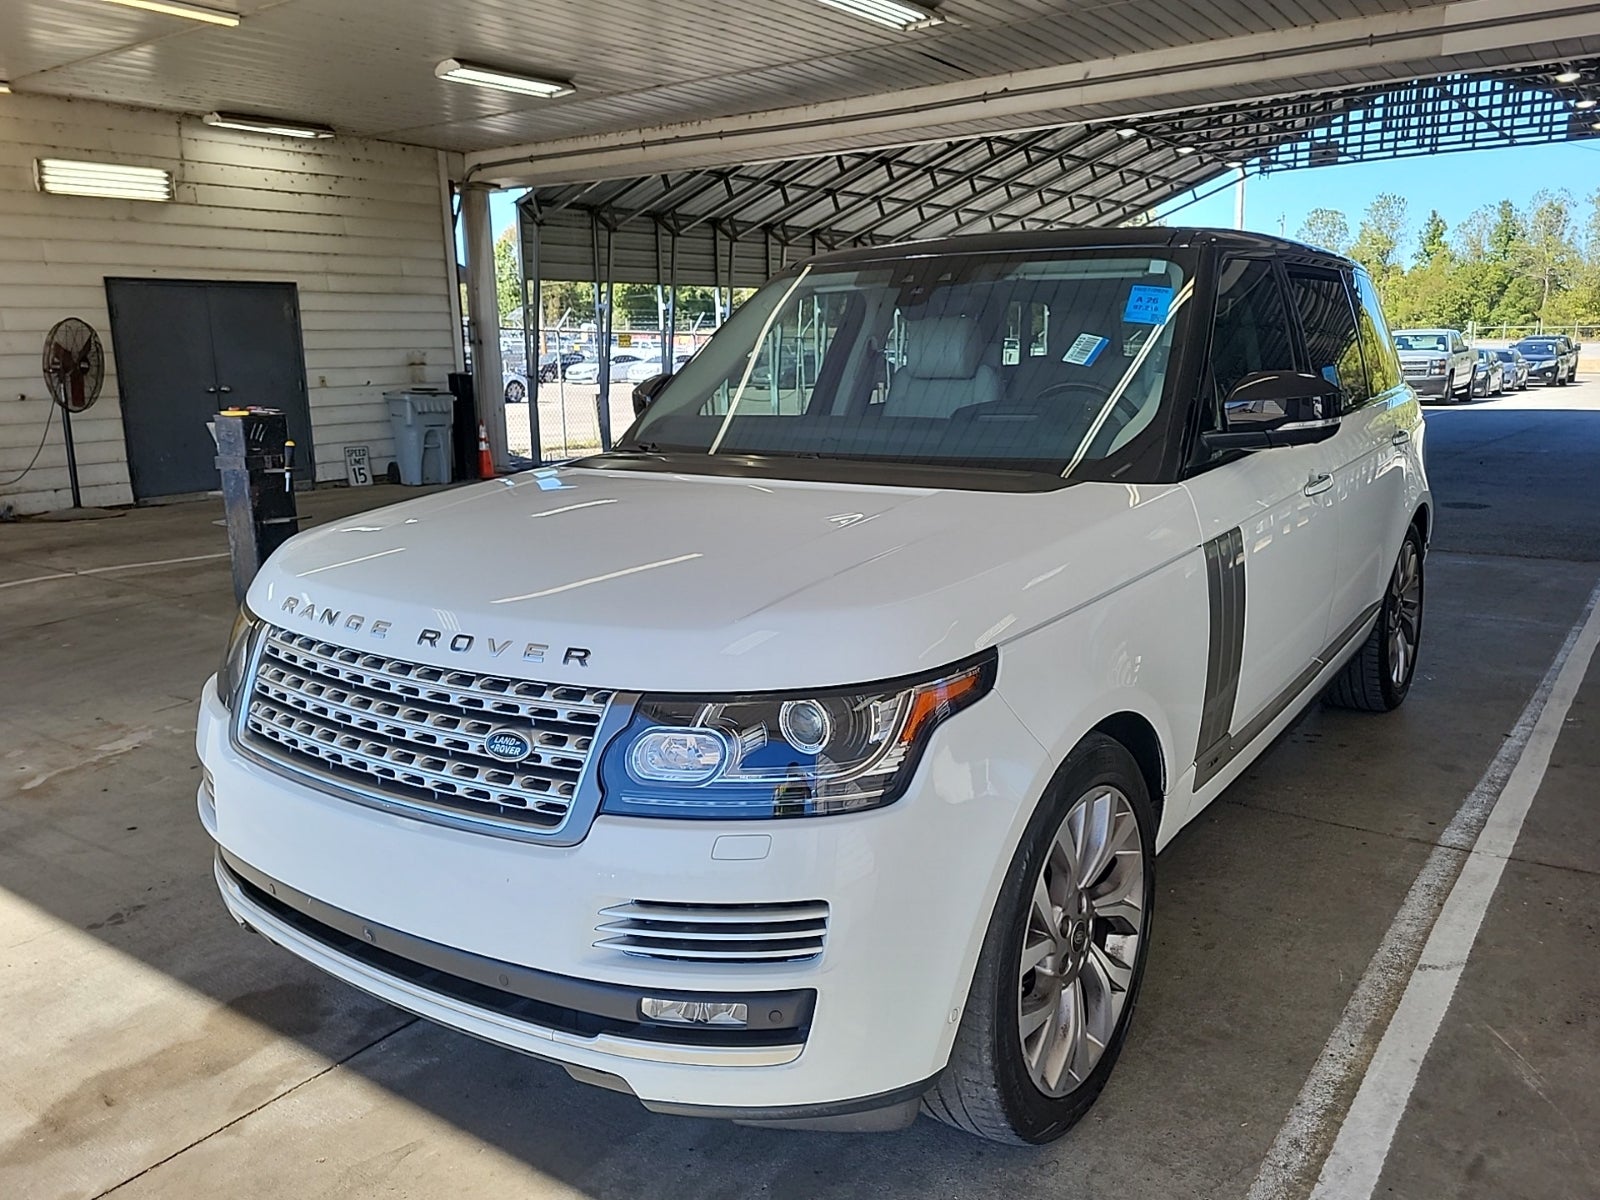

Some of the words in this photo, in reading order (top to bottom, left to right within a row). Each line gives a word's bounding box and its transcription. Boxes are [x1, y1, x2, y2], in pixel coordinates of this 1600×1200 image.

[346, 448, 367, 458] SPEED
[350, 457, 365, 466] LIMIT
[352, 467, 368, 484] 15
[280, 596, 393, 640] RANGE
[416, 628, 593, 668] ROVER
[493, 735, 517, 746] LAND
[493, 743, 522, 756] ROVER
